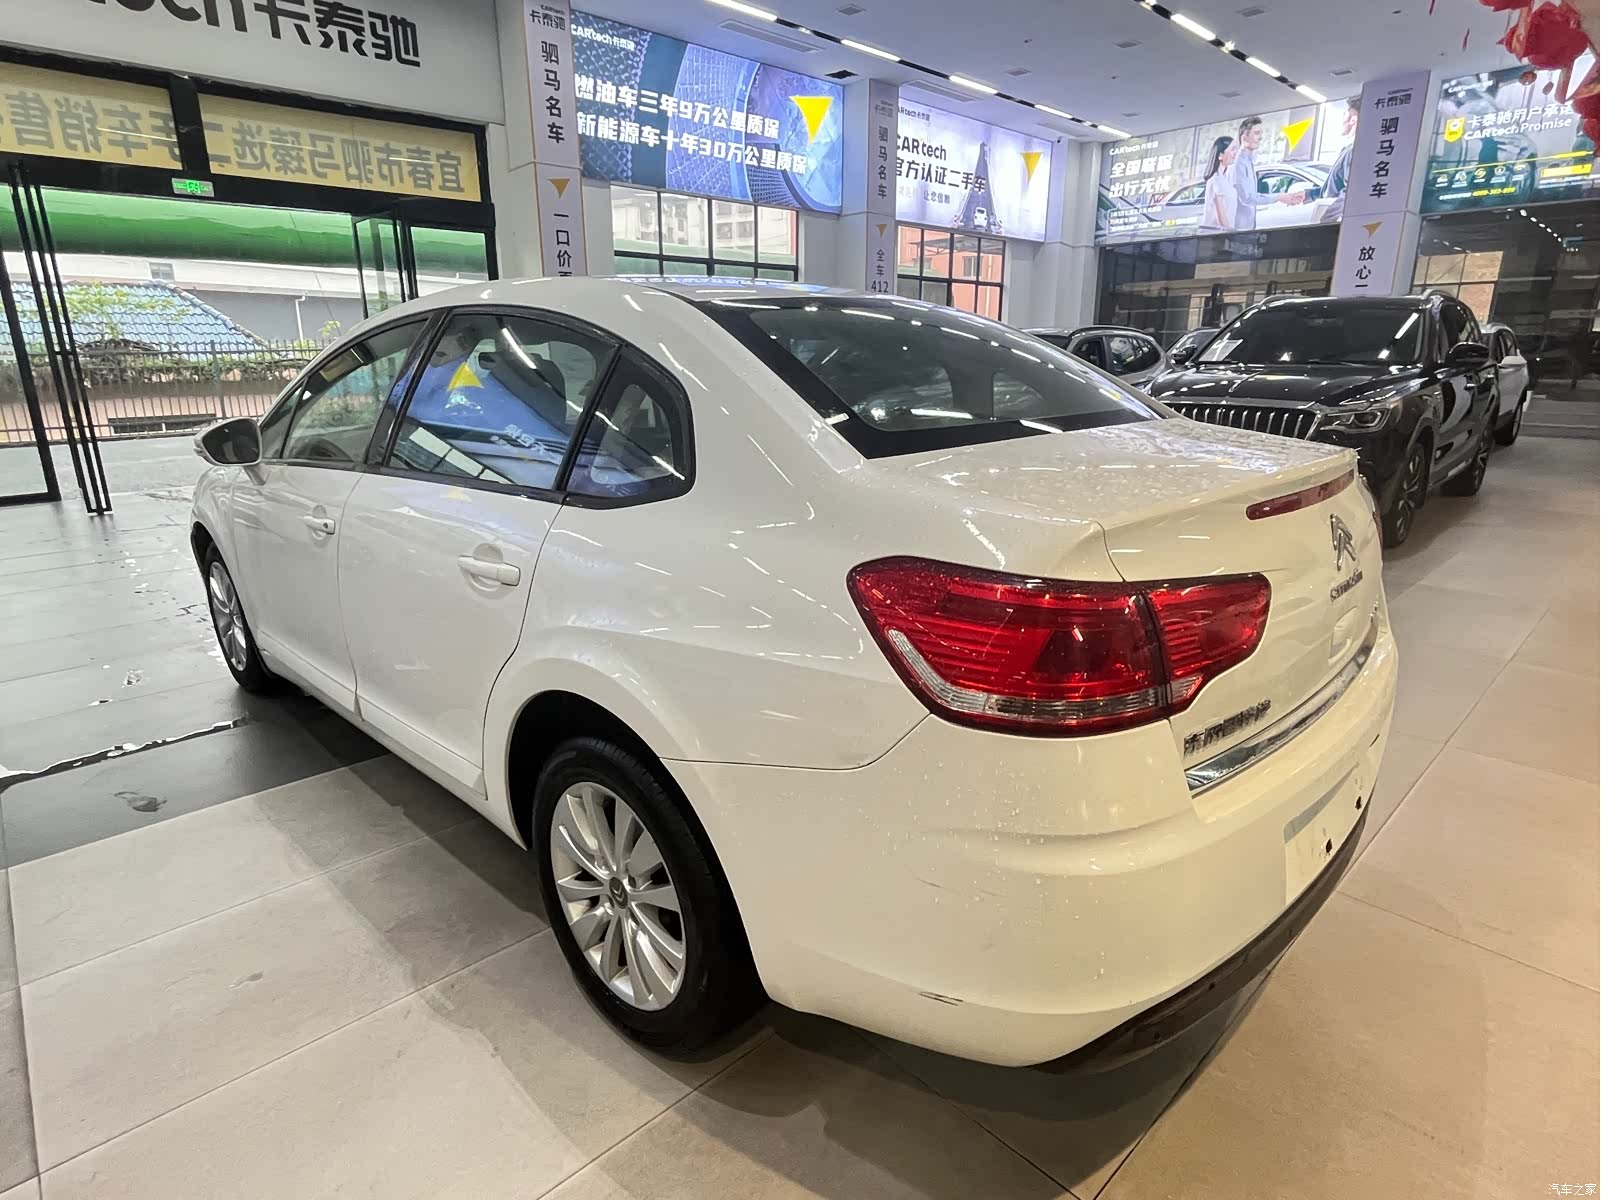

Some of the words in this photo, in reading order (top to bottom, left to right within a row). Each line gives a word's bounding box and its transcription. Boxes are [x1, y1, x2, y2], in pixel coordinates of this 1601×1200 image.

[541, 41, 565, 143] 驷马名车
[574, 73, 780, 139] 燃油车三年9万公里质保
[1467, 101, 1574, 129] 卡泰驰用户承诺
[576, 111, 808, 175] 新能源车十年30万公里质保
[1369, 116, 1399, 198] 驷马名车
[1464, 125, 1519, 140] CARtech
[1520, 118, 1572, 133] Promise
